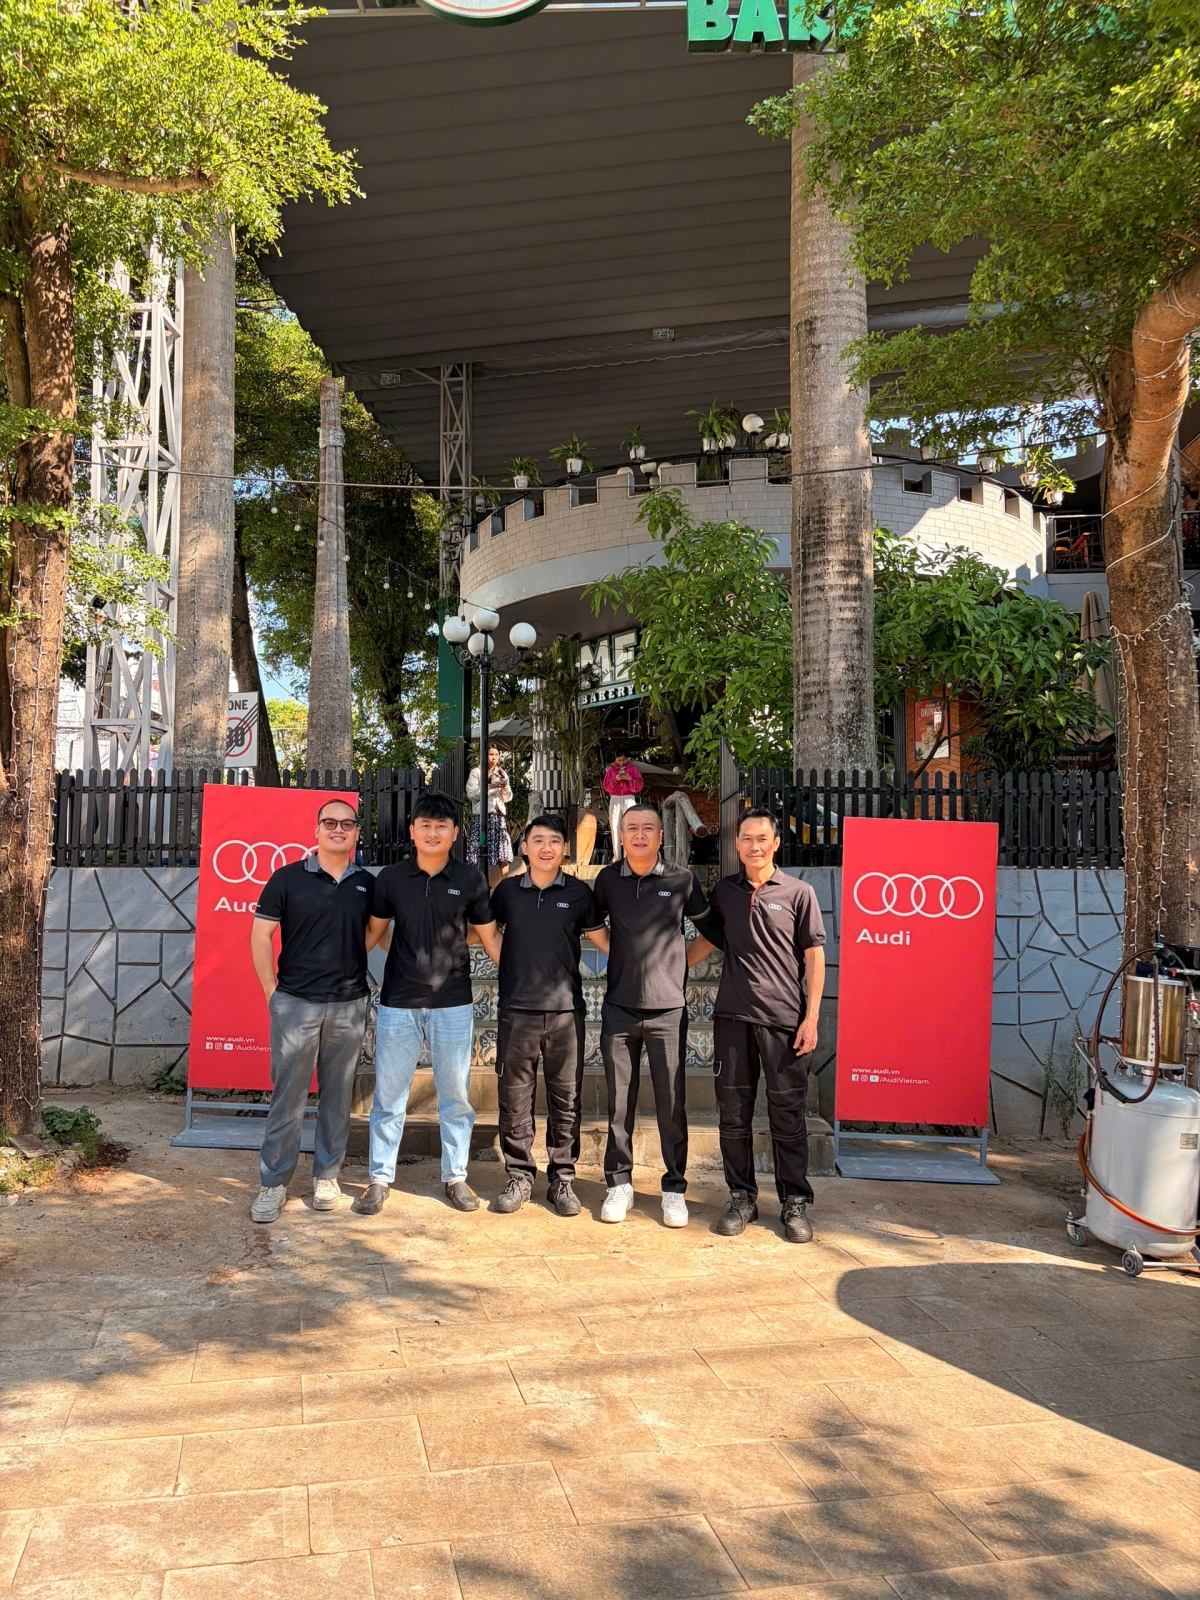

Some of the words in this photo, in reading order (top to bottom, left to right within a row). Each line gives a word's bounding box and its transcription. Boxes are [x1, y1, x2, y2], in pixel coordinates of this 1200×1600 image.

[581, 684, 635, 705] BAKERY
[228, 699, 249, 711] ONE
[213, 896, 258, 914] Au
[855, 927, 911, 946] Audi
[233, 1044, 272, 1052] /AudiVietn
[879, 1077, 930, 1085] /AudiVietnam
